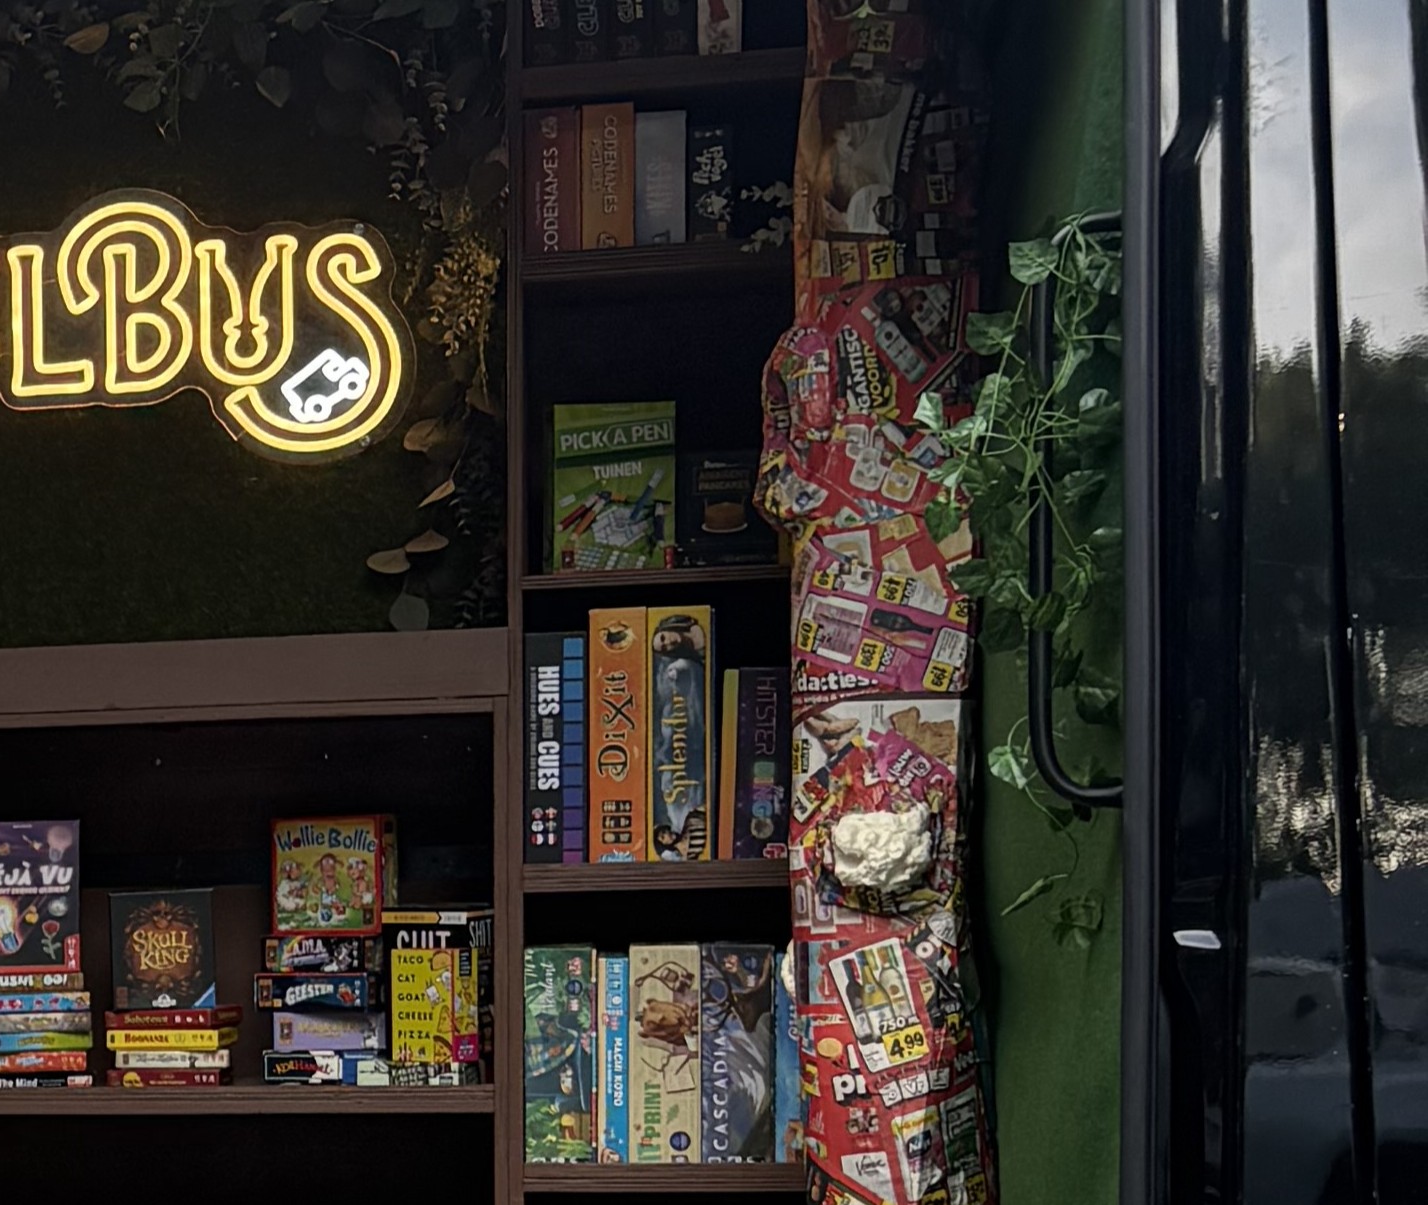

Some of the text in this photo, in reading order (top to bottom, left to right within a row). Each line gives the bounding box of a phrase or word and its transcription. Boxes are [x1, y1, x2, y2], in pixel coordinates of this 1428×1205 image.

[603, 114, 618, 215] CODENAMES
[544, 147, 558, 253] CODENAMES
[560, 423, 670, 452] PICK A PEN
[593, 461, 643, 481] TUINEN
[538, 665, 560, 715] HUES
[755, 676, 777, 757] HITSTER
[658, 692, 699, 806] Splendor
[538, 740, 560, 791] CUES
[275, 825, 377, 853] Wollie Bollie
[39, 865, 73, 885] VU
[132, 928, 193, 951] SKULL
[139, 947, 190, 971] KING
[397, 955, 424, 965] TACO
[397, 974, 416, 983] CAT
[397, 993, 425, 1002] GOAT
[397, 1012, 433, 1021] CHEESE
[880, 1017, 907, 1034] 750
[397, 1030, 430, 1039] PIZZA
[15, 1078, 38, 1088] Mind
[712, 1034, 728, 1151] CASCADIA
[644, 1081, 661, 1141] PRINT
